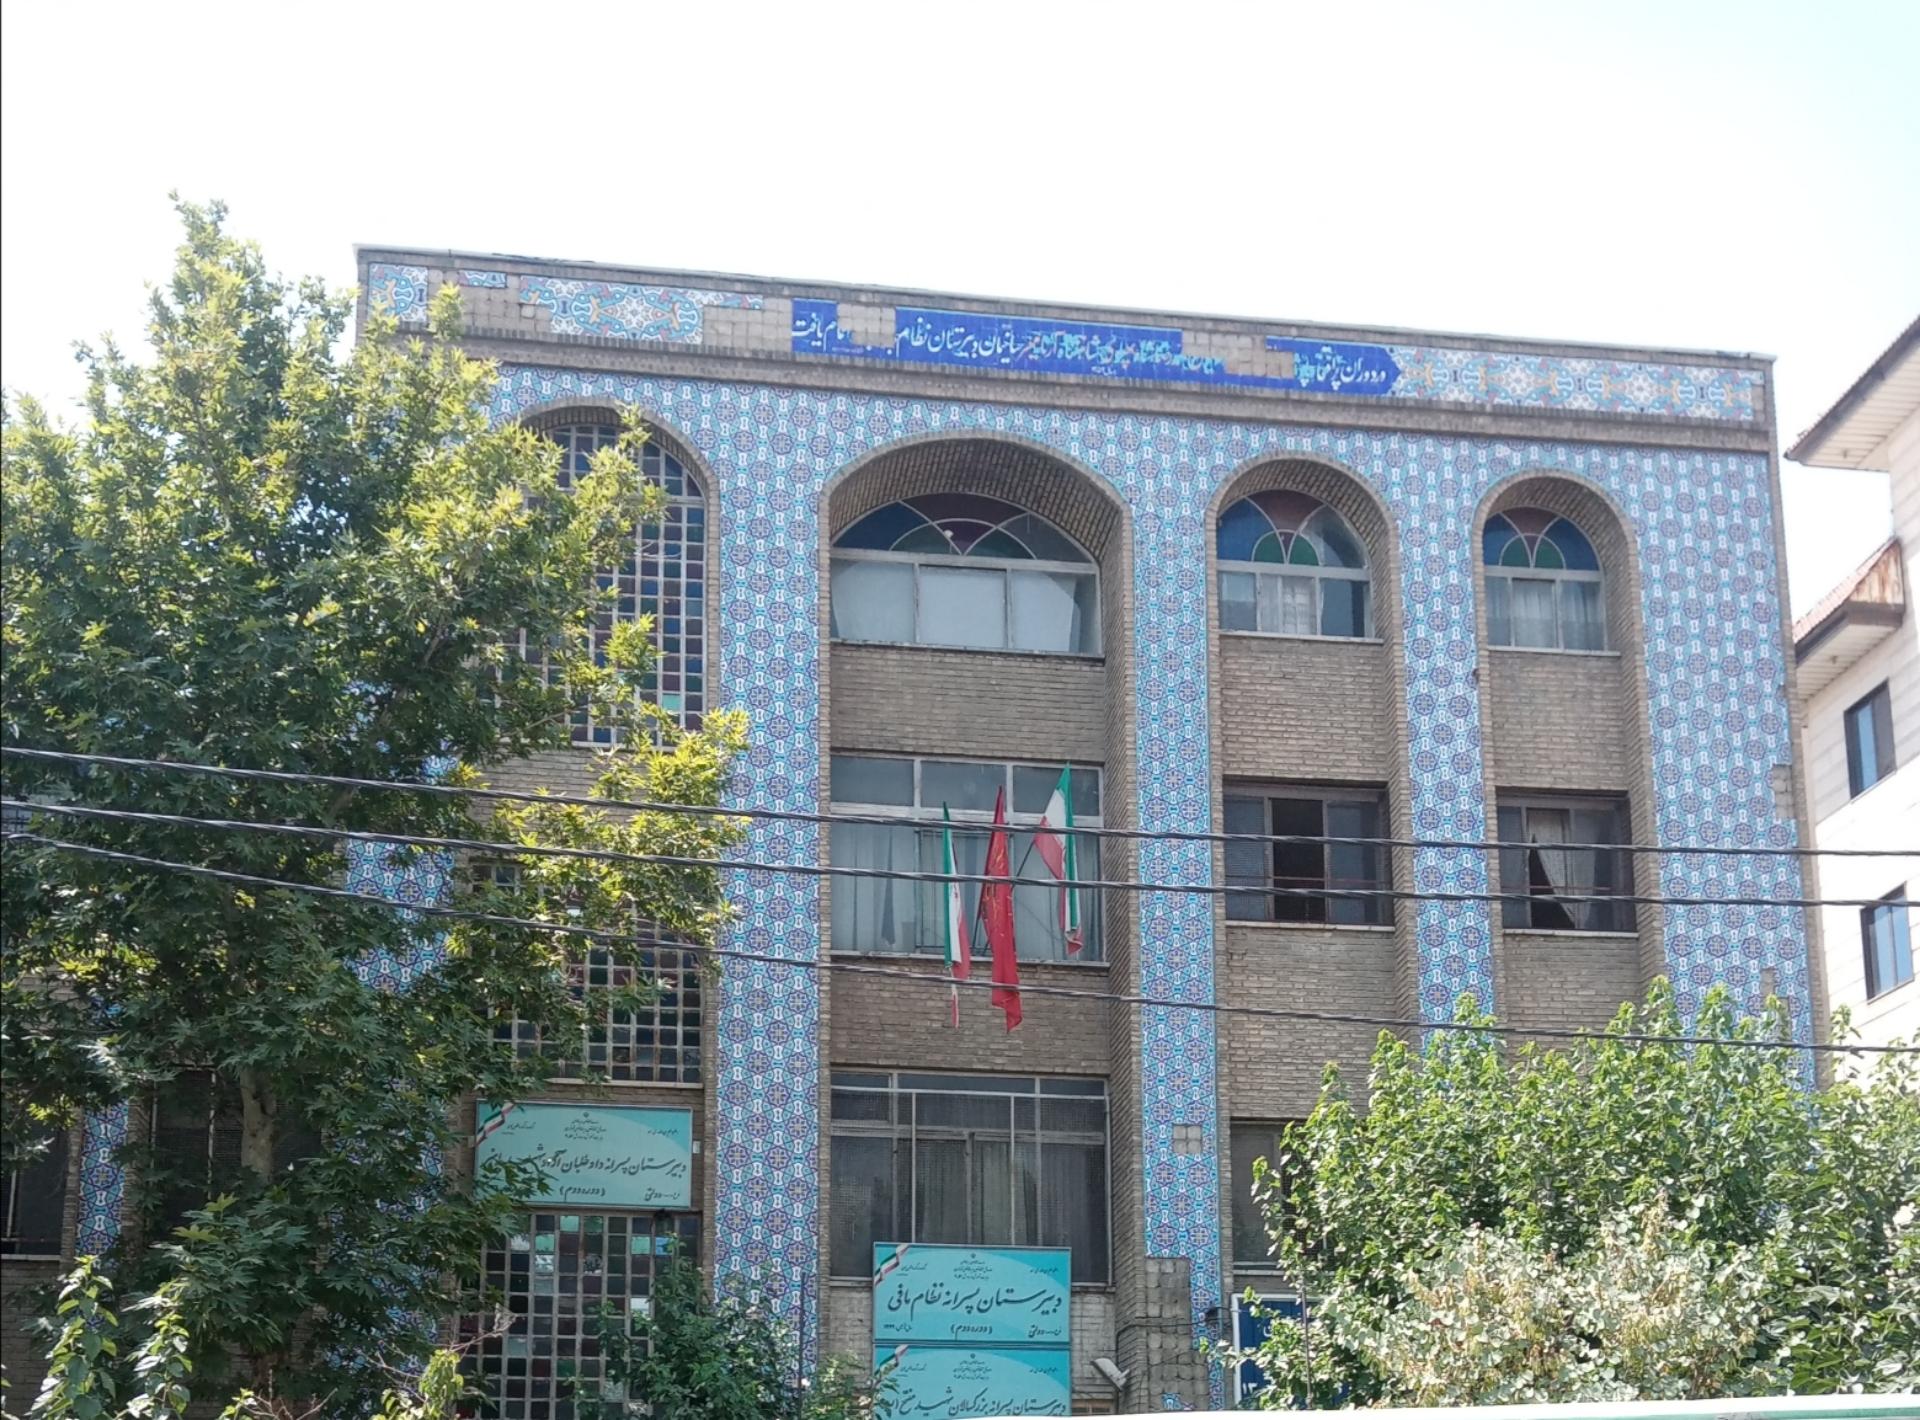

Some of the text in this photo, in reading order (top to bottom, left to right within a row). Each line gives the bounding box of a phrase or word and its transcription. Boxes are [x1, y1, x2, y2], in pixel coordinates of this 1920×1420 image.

[792, 312, 823, 346] یافت
[896, 317, 932, 359] نظام
[927, 326, 978, 359] دبیرستان
[561, 1154, 604, 1173] داوطلبان
[604, 1157, 631, 1174] پسرانه
[628, 1156, 687, 1178] دبیرستان
[888, 1282, 1062, 1321] دبیرستان پسرانه نظام مافی
[914, 1386, 954, 1416] شهید
[989, 1399, 1014, 1416] پسرانه
[1013, 1399, 1066, 1416] دبیرستان
